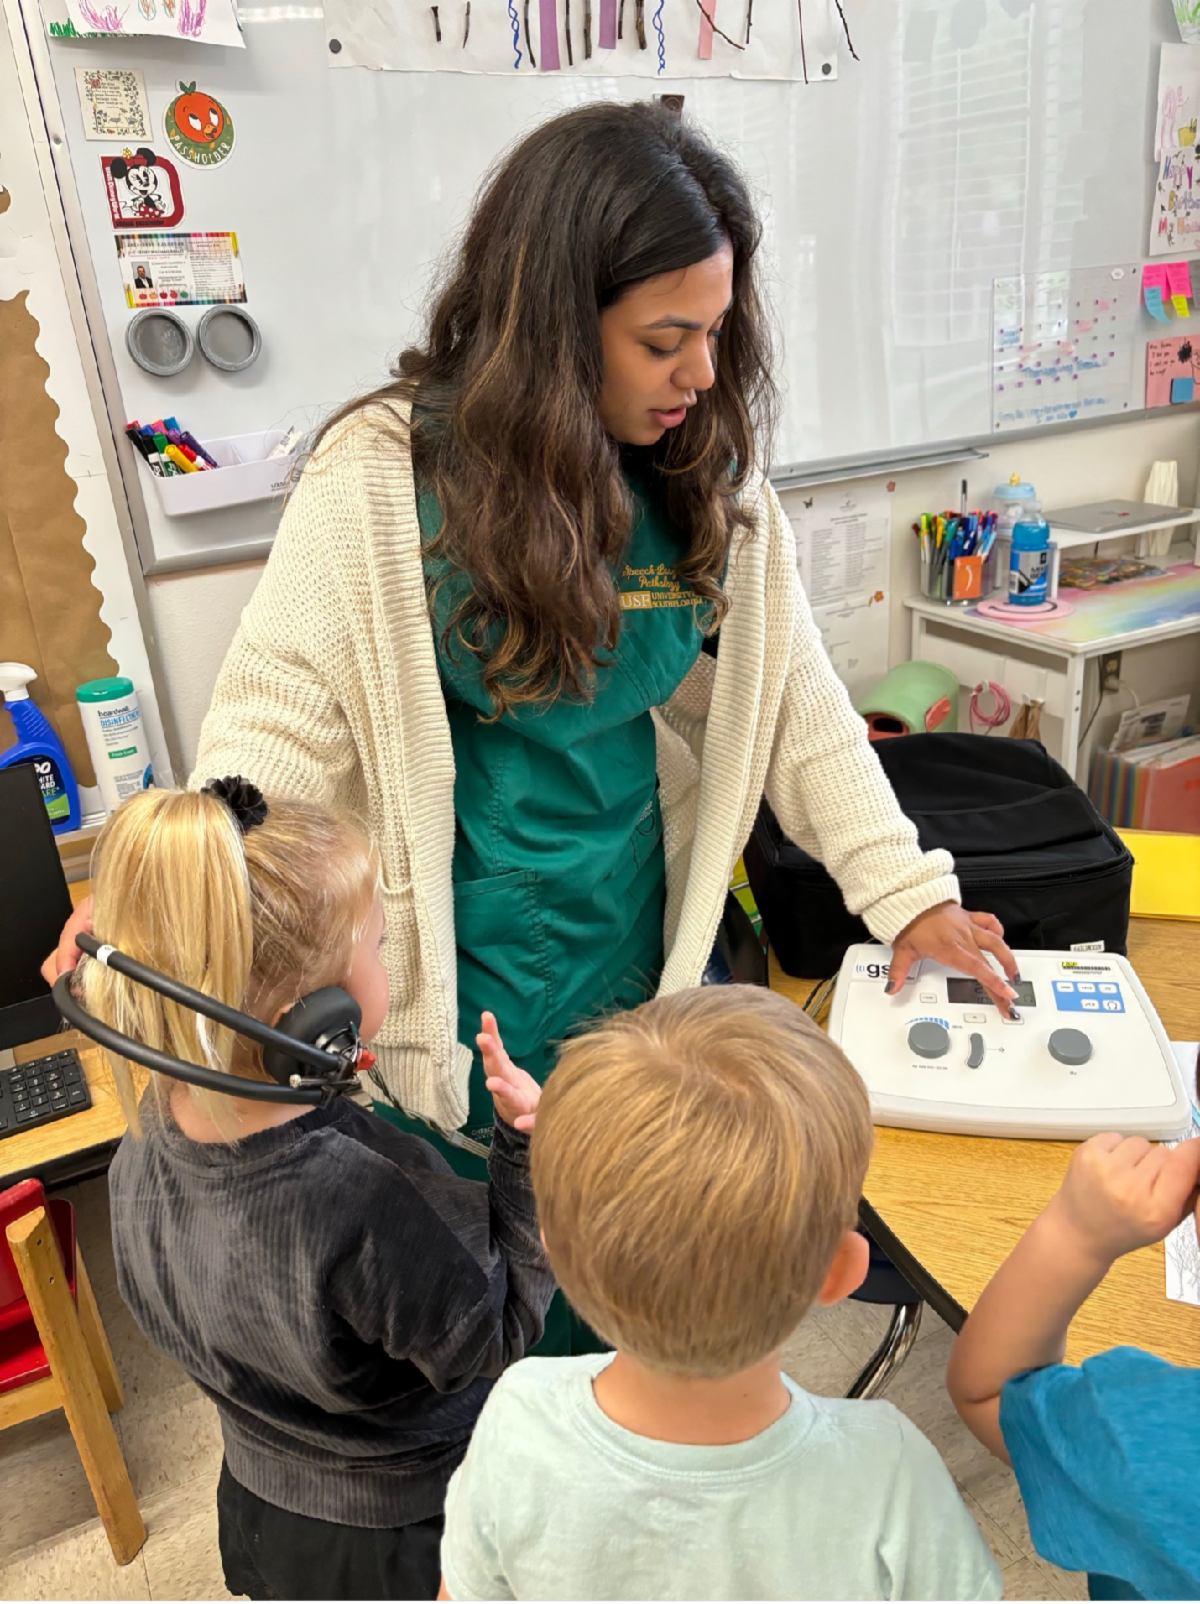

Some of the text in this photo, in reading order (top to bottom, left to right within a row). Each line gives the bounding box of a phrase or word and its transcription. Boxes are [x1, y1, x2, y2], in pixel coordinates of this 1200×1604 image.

[170, 135, 230, 164] PASSHOLDER
[639, 576, 681, 592] Pathology
[621, 595, 650, 608] USF
[866, 963, 891, 978] gs
